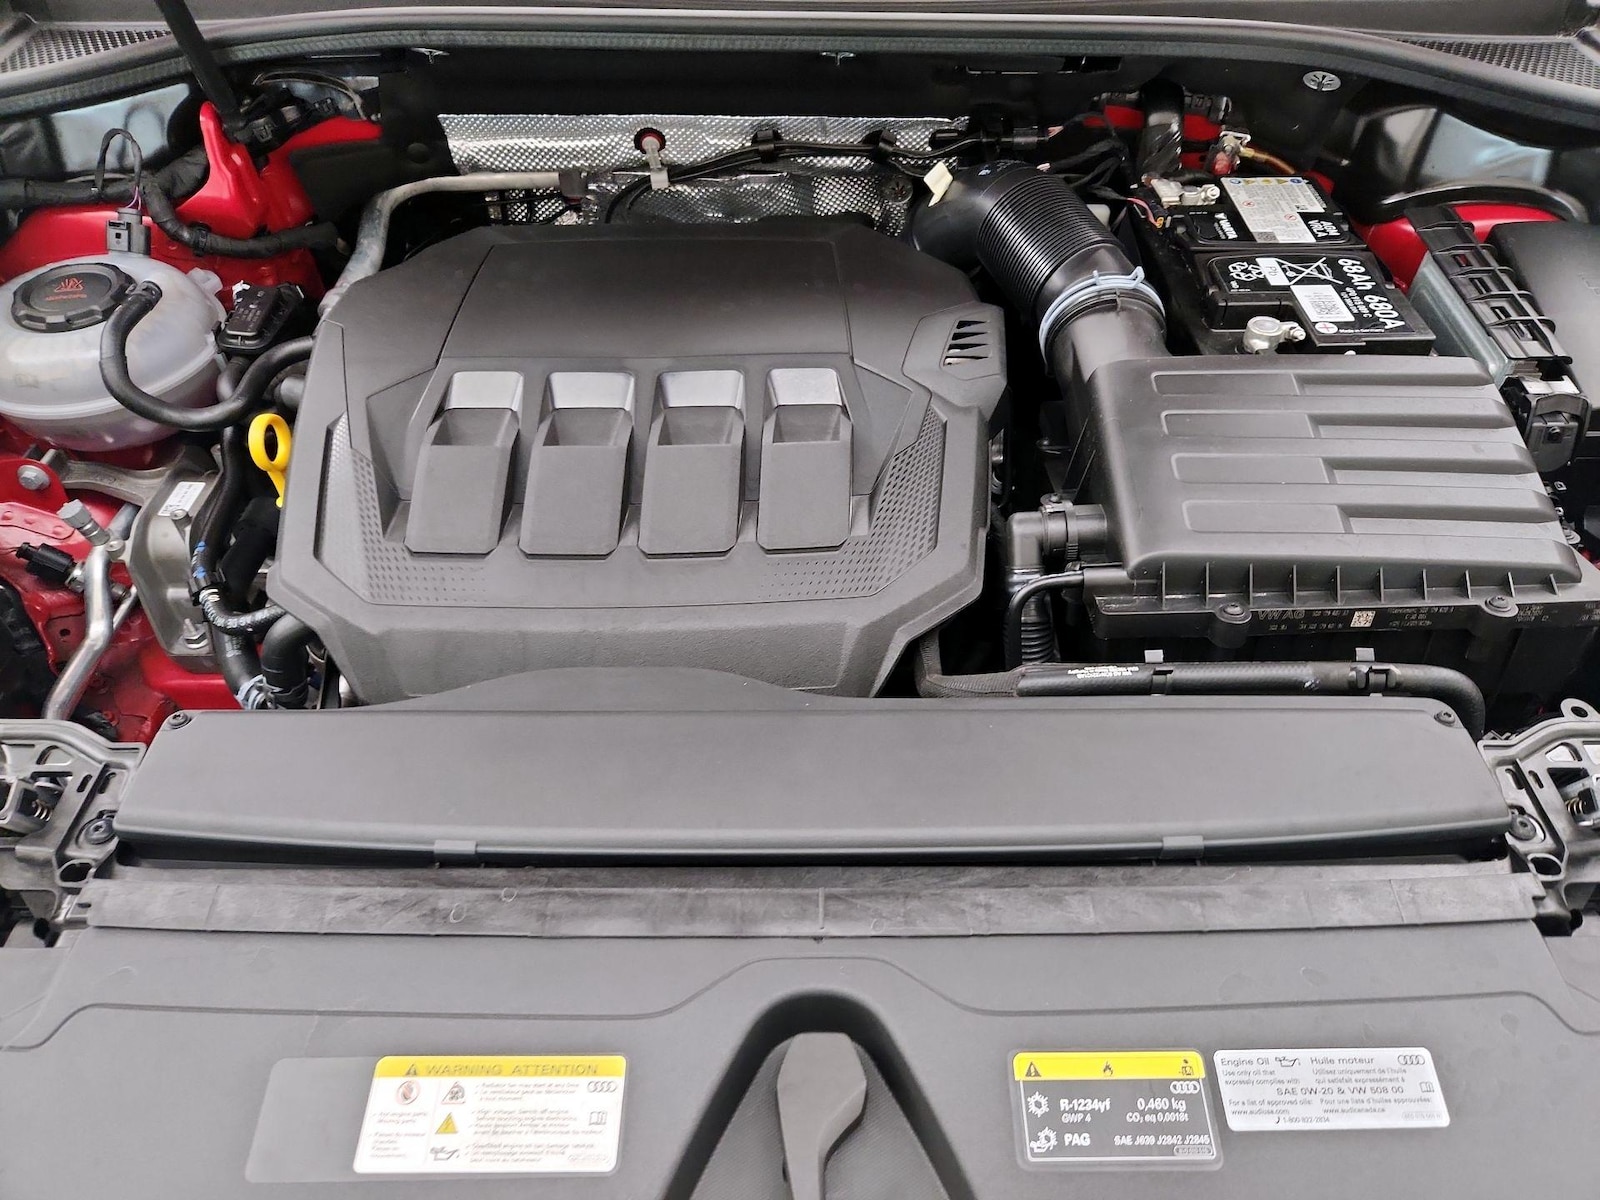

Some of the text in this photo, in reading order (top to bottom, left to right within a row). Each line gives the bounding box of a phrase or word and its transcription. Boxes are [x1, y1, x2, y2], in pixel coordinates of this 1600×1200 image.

[1308, 219, 1328, 237] VRLA
[1318, 220, 1340, 236] AGM
[1338, 258, 1376, 290] 68Ah
[1364, 295, 1405, 329] 680A
[1258, 610, 1280, 620] VW
[1282, 609, 1306, 619] AG
[1221, 1057, 1270, 1068] Engine Oil
[1310, 1057, 1374, 1065] Huile moteur
[426, 1063, 600, 1075] WARNING ATTENTION
[1276, 1085, 1404, 1096] SAE 0W-20 & VW 508 00
[1060, 1097, 1111, 1113] R-1234yf
[1171, 1097, 1187, 1112] kg
[1061, 1112, 1092, 1124] GWP 4
[1145, 1113, 1156, 1124] eq
[1063, 1132, 1091, 1147] PAG
[1114, 1135, 1133, 1146] SAE
